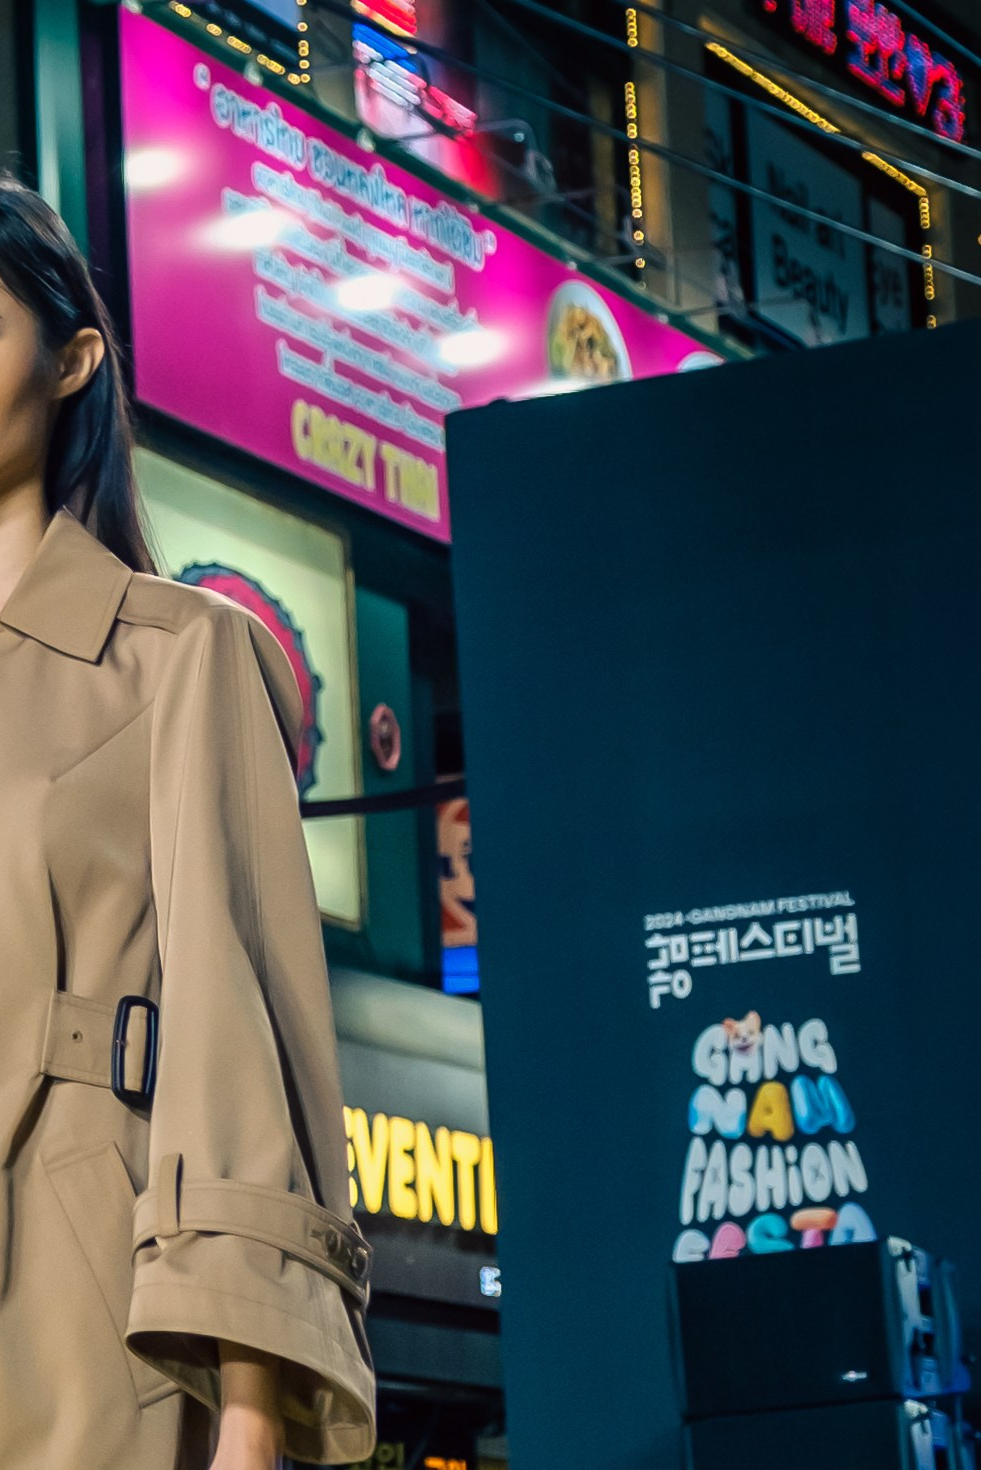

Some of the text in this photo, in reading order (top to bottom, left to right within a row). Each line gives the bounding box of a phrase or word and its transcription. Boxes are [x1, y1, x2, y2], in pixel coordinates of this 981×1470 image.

[776, 890, 856, 914] FESTIVAL
[691, 1014, 837, 1086] GANG
[688, 1074, 856, 1142] NAM
